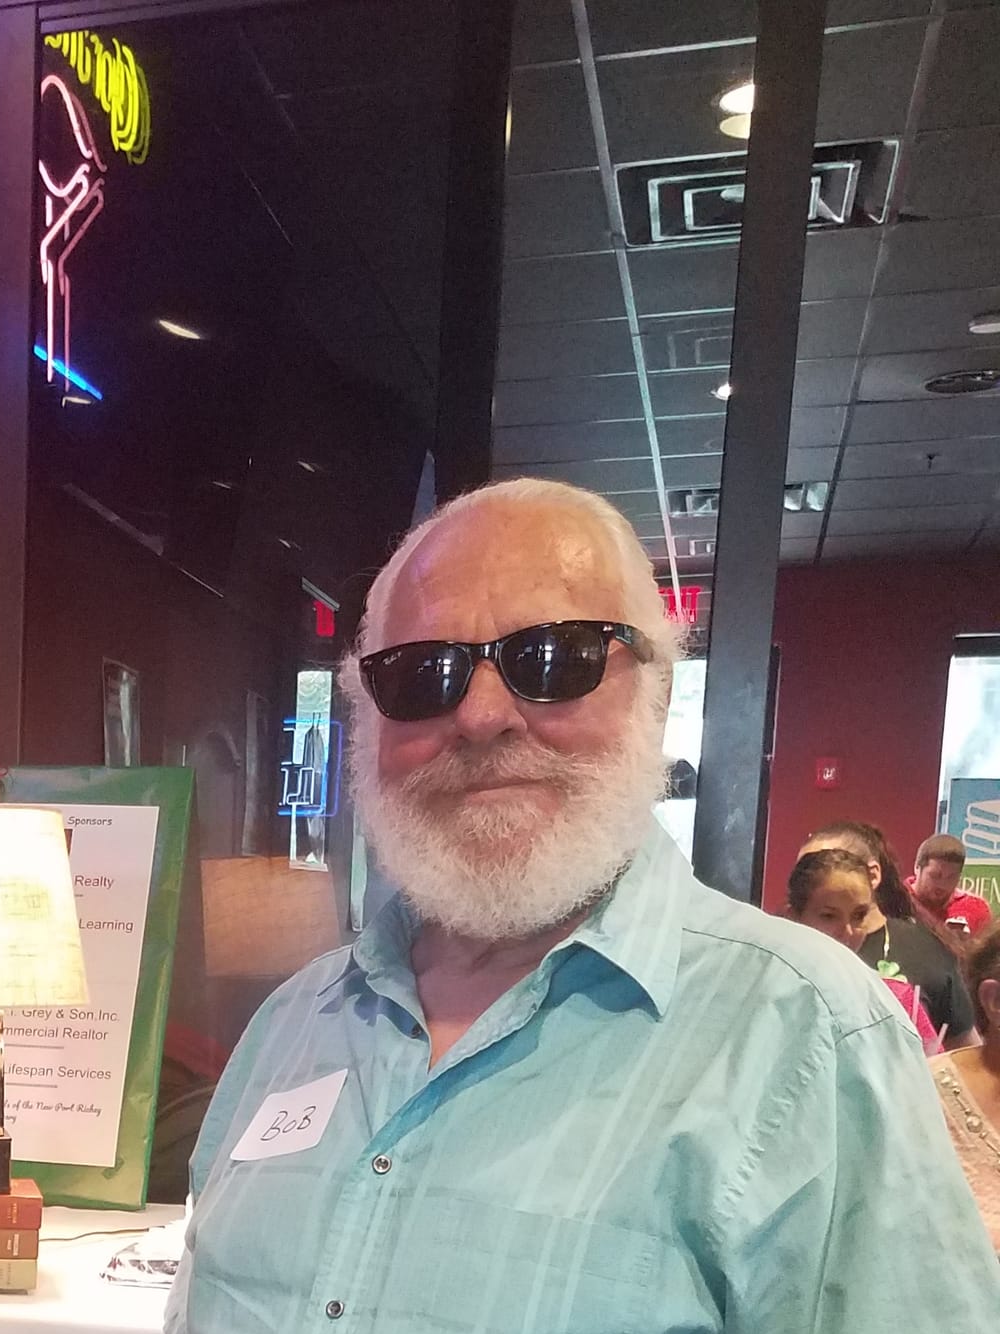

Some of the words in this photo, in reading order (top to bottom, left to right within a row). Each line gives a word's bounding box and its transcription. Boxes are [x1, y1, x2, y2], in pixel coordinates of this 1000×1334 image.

[67, 816, 113, 827] Sponsors
[74, 875, 115, 890] Realty
[961, 876, 1000, 905] RIEN
[78, 918, 134, 934] Learning
[22, 1008, 53, 1021] Grey
[56, 1008, 65, 1019] &
[3, 1026, 59, 1039] mmercial
[62, 1027, 109, 1041] Realtor
[57, 1065, 112, 1080] Services
